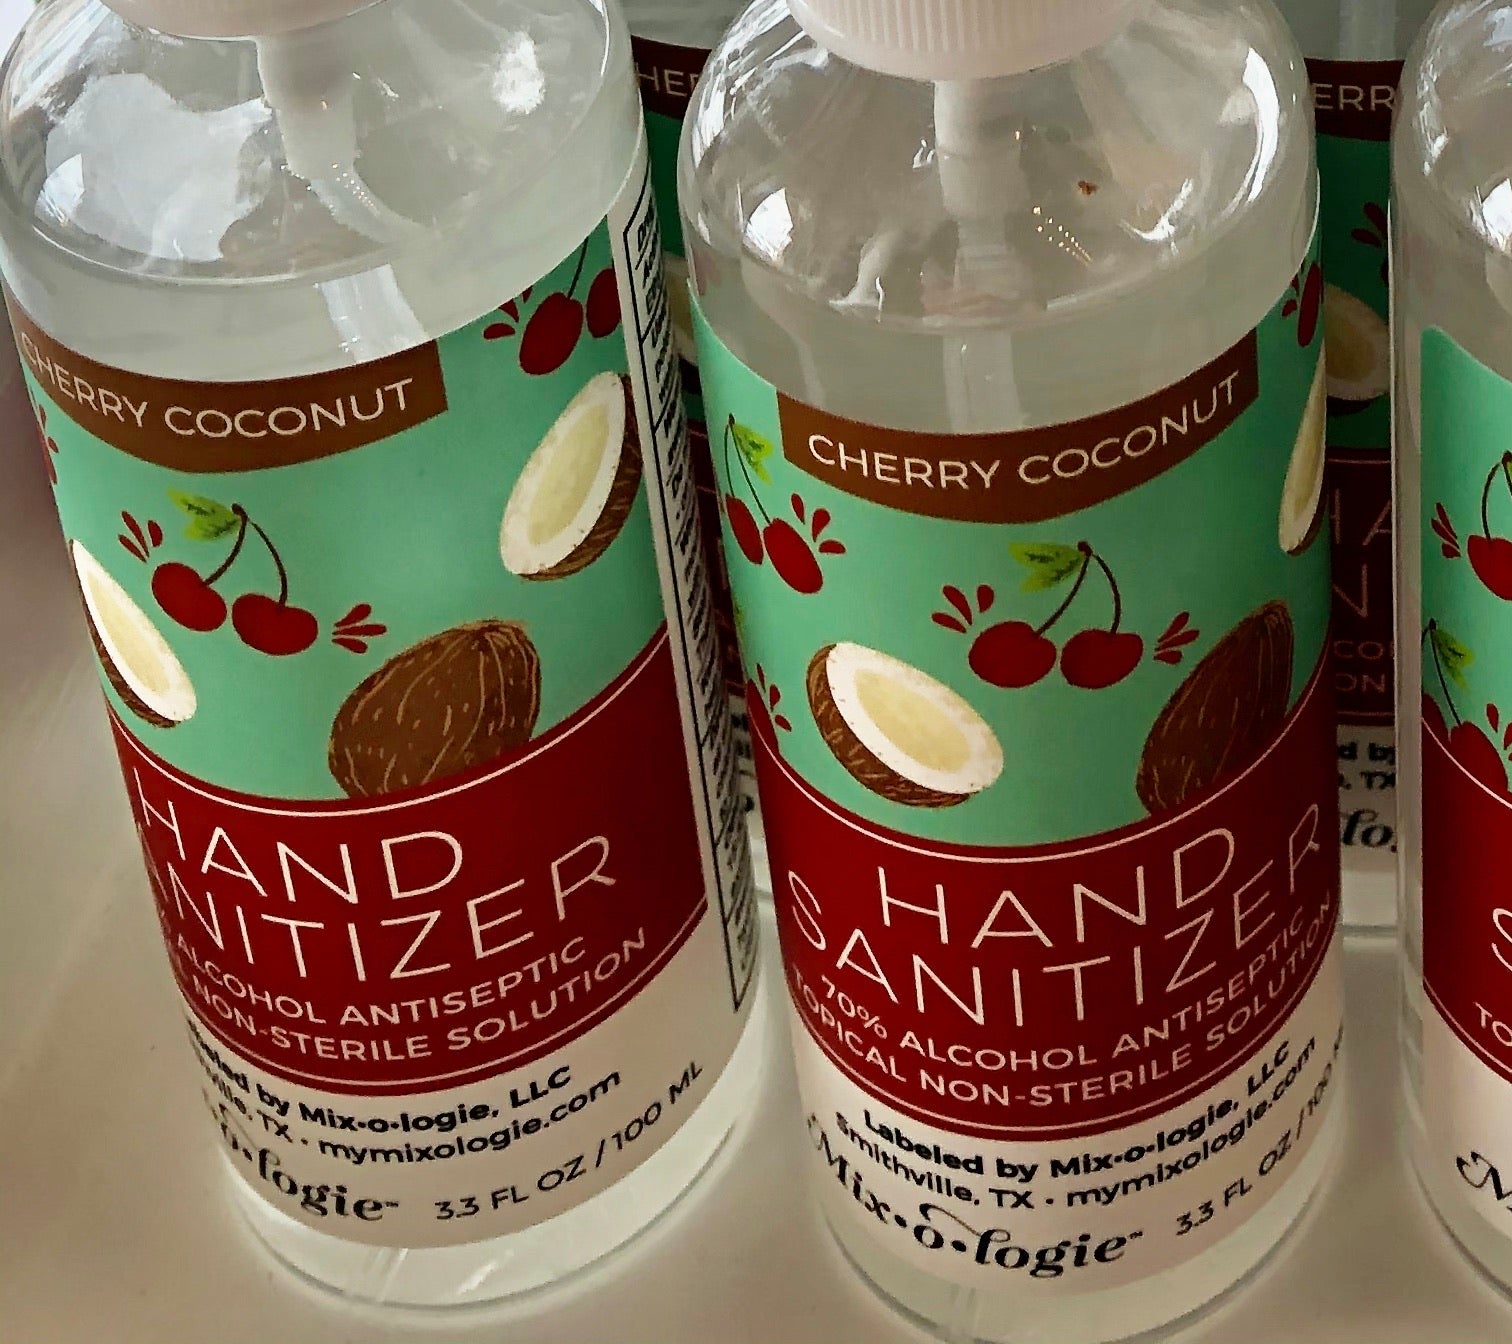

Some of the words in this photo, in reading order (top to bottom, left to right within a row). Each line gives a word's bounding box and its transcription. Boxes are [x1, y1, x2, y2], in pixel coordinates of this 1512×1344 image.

[21, 331, 148, 430] CHERRY
[164, 378, 415, 439] COCONUT
[806, 433, 1001, 491] CHERRY
[1016, 370, 1240, 487] COCONUT
[133, 767, 463, 904] HAND
[876, 827, 1236, 950] HAND
[177, 932, 327, 1025] ALCOHOL
[339, 936, 587, 1027] ANTISEPTIC
[787, 803, 1322, 1027] SANITIZER
[192, 974, 433, 1061] NON-STERILE
[446, 926, 646, 1052] SOLUTION
[820, 973, 889, 1041] 70%
[898, 1028, 1099, 1074] ALCOHOL
[1111, 905, 1304, 1060] ANTISEPTIC
[920, 1046, 1194, 1109] NON-STERILE
[1204, 889, 1331, 1053] SOLUTION
[318, 1070, 622, 1165] mymixologie.com
[490, 1184, 529, 1210] FL
[536, 1155, 588, 1192] OZ
[611, 1101, 662, 1151] 100
[668, 1060, 704, 1105] ML
[509, 1064, 572, 1110] LLC
[863, 1108, 985, 1178] Labeled
[995, 1143, 1040, 1184] by
[1246, 1040, 1290, 1097] LLC
[989, 1187, 1036, 1211] TX
[1066, 1036, 1317, 1209] mymixologie.com
[1223, 1177, 1253, 1208] FL
[1258, 1129, 1292, 1177] OZ
